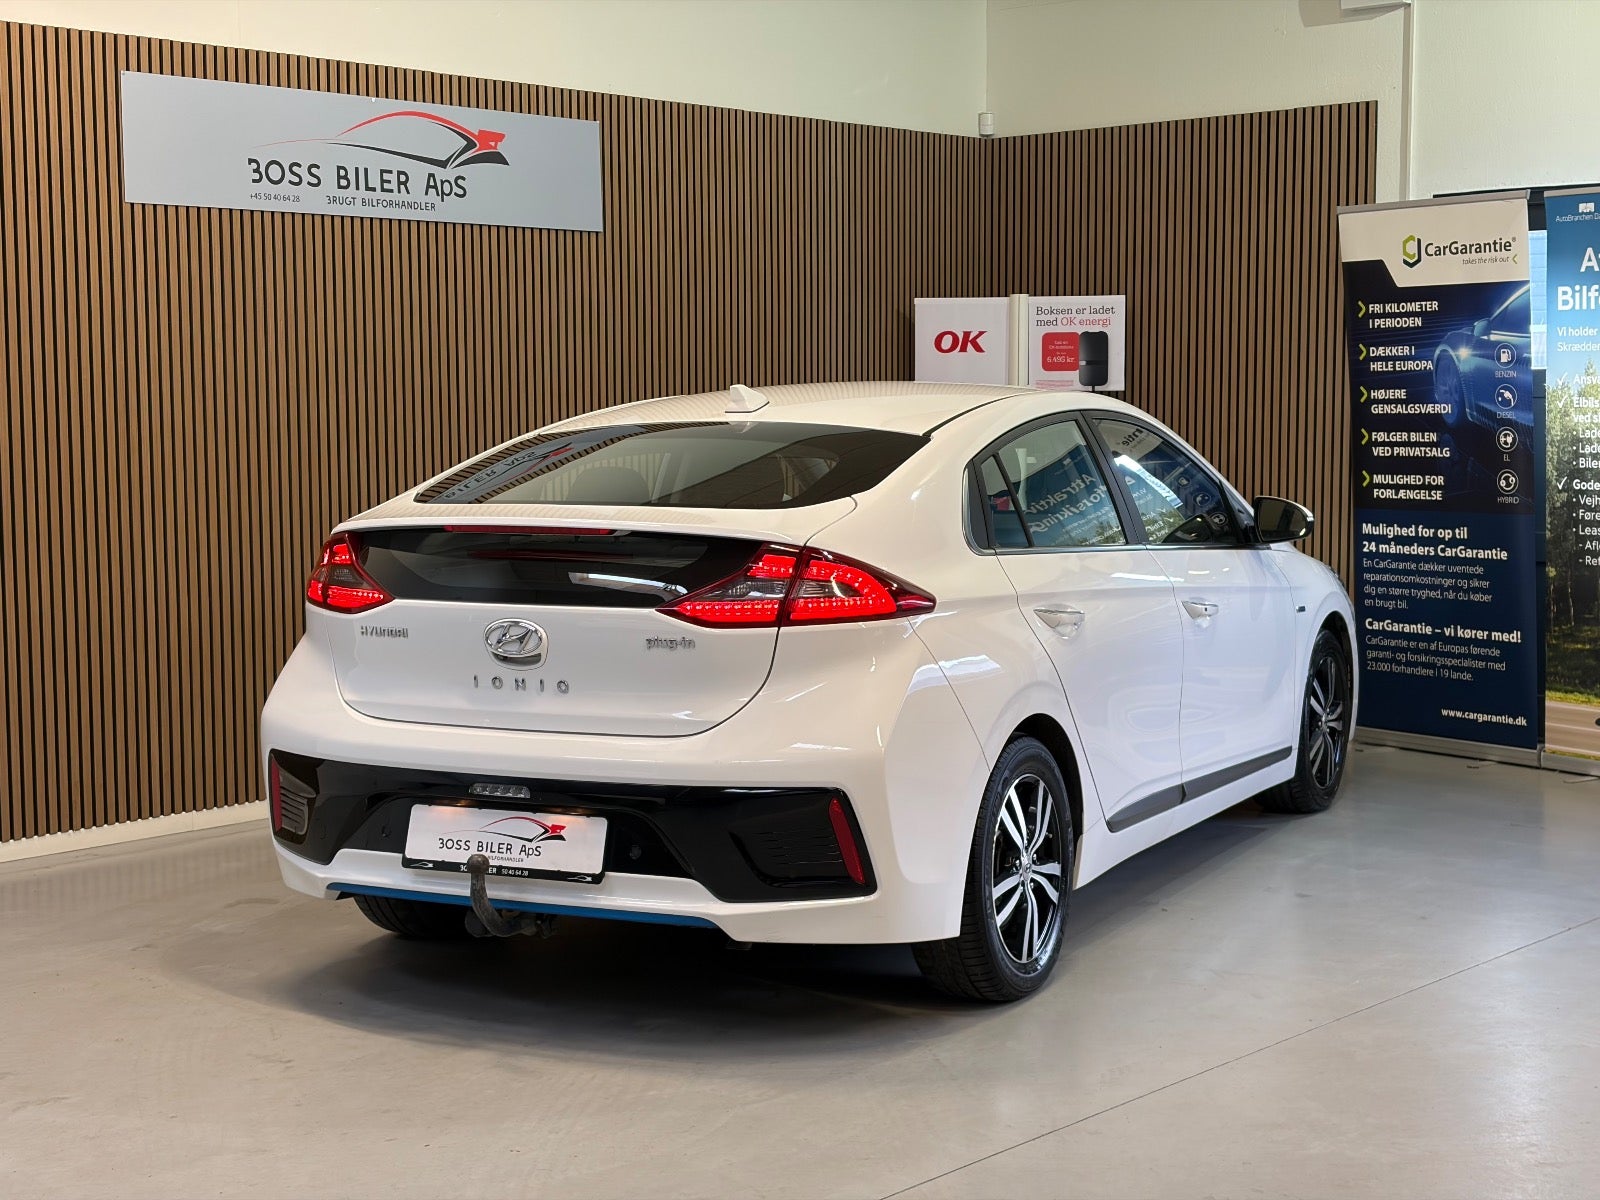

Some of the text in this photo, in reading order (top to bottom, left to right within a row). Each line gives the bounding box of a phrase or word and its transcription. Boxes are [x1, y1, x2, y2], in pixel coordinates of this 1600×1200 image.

[336, 165, 411, 195] BILER
[424, 172, 467, 202] ApS
[250, 192, 301, 202] +45 50 40 64 28
[361, 198, 436, 212] BILFORHANDLER
[1580, 247, 1600, 273] A
[1557, 284, 1600, 311] Bilf
[1035, 306, 1116, 316] Boksen er ladet
[1369, 301, 1439, 314] FRI KILOMETER
[1036, 317, 1111, 328] med OK energi
[1374, 317, 1422, 328] PERIODEN
[1557, 326, 1598, 337] Vi holder
[933, 330, 988, 354] OK
[1369, 346, 1410, 357] DÆKKER
[1370, 360, 1434, 372] HELE EUROPA
[1495, 370, 1517, 378] BENZIN
[1370, 389, 1407, 400] HØJERE
[1371, 403, 1452, 414] GENSALGSVÆRDI
[1496, 411, 1516, 419] DIESEL
[1371, 431, 1437, 442] FØLGER BILEN
[1372, 446, 1451, 458] VED PRIVATSALG
[1373, 474, 1444, 485] MULIGHED FOR
[1373, 488, 1443, 501] FORLÆNGELSE
[1362, 523, 1468, 541] Mulighed for op til
[1362, 541, 1508, 560] 24 måneders CarGarantie
[1363, 559, 1484, 575] En CarGarantie dækker uventede
[1363, 572, 1490, 589] reparationsomkostninger og sikrer
[1364, 584, 1376, 595] dig
[1388, 587, 1410, 596] større
[1411, 588, 1443, 600] tryghed,
[1444, 590, 1456, 599] når
[1457, 591, 1468, 600] du
[1469, 591, 1492, 602] køber
[1364, 598, 1408, 610] en brugt bil.
[1365, 618, 1432, 635] CarGarantie
[1444, 625, 1454, 637] vi
[1457, 625, 1489, 640] kører
[1491, 631, 1521, 643] med!
[645, 636, 696, 651] plug-in
[1365, 635, 1500, 657] CarGarantie er en af Europas førende
[1366, 649, 1506, 671] garanti- og forsikringsspecialister med
[1367, 661, 1391, 672] 23.000
[1392, 663, 1434, 676] forhandlere
[1440, 668, 1449, 678] 19
[1450, 670, 1474, 681] lande.
[473, 674, 570, 695] IONIQ
[1441, 708, 1527, 727] www.cargarantie.dk
[477, 840, 513, 854] BILER
[519, 844, 542, 858] ApS
